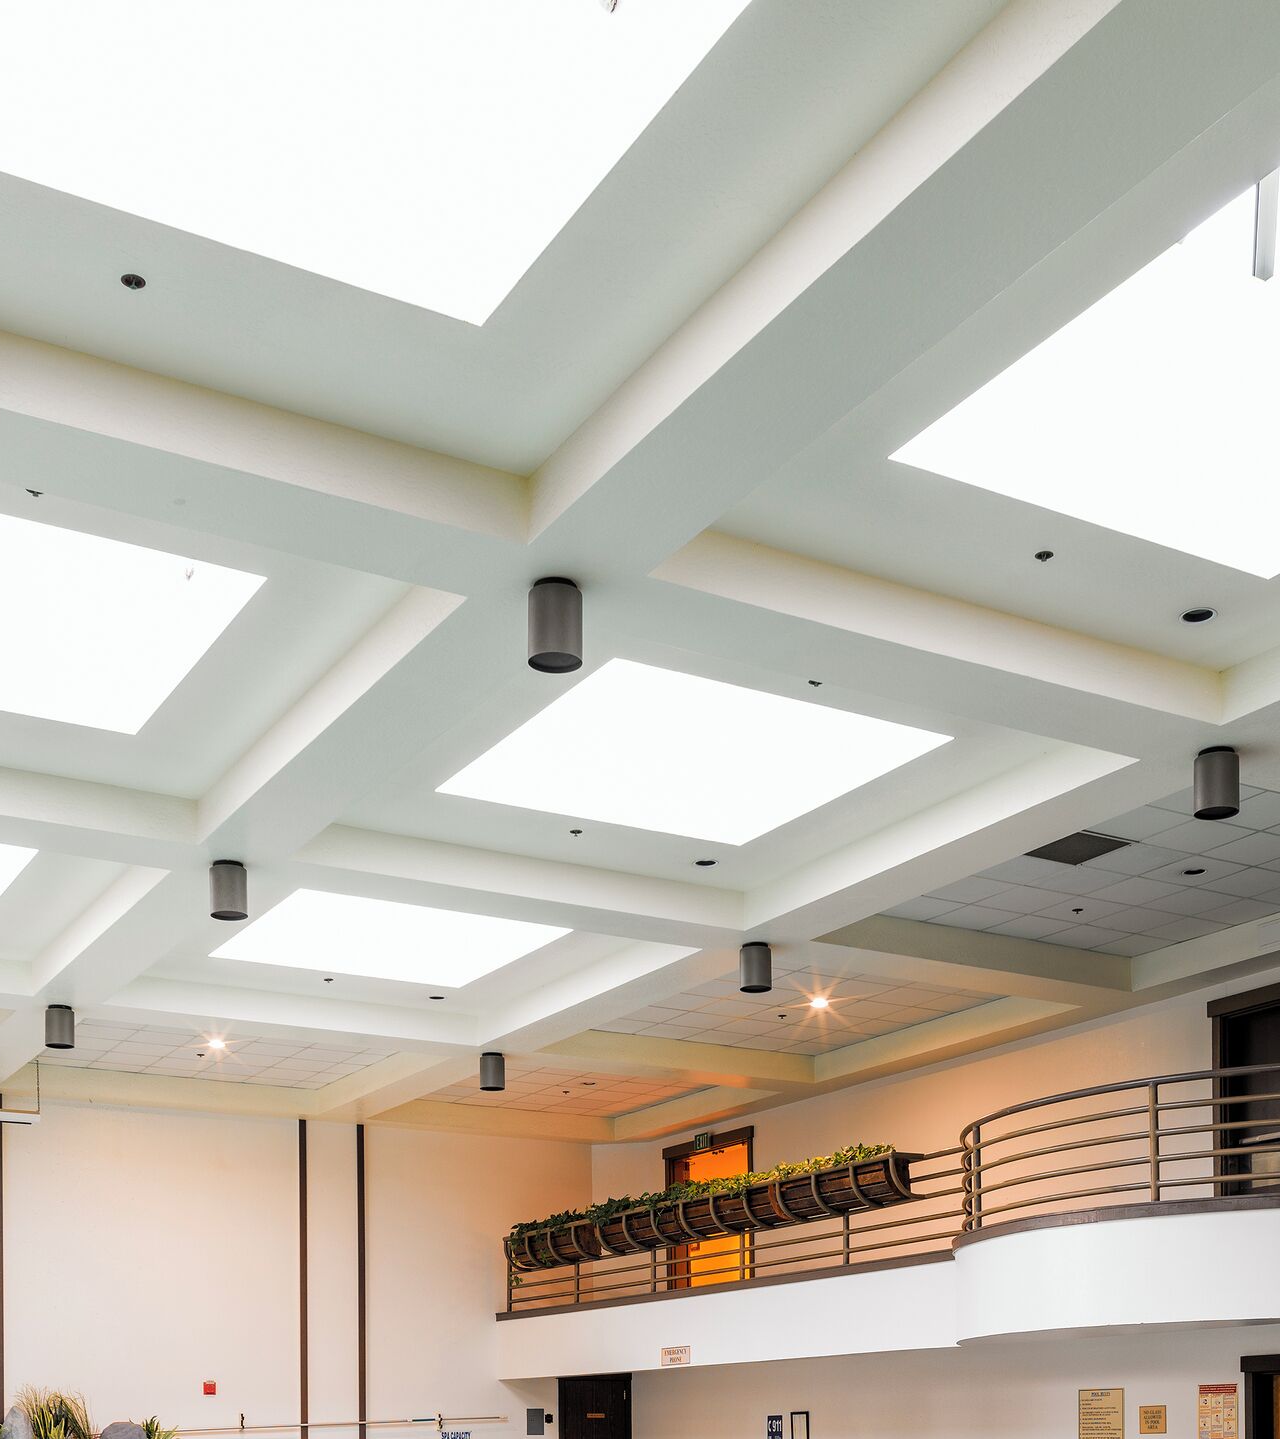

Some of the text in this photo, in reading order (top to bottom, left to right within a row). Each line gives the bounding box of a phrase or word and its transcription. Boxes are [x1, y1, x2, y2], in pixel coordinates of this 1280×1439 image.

[696, 1134, 707, 1149] EXIT
[772, 1420, 782, 1432] 911
[441, 1431, 471, 1439] SPA CAPACITY
